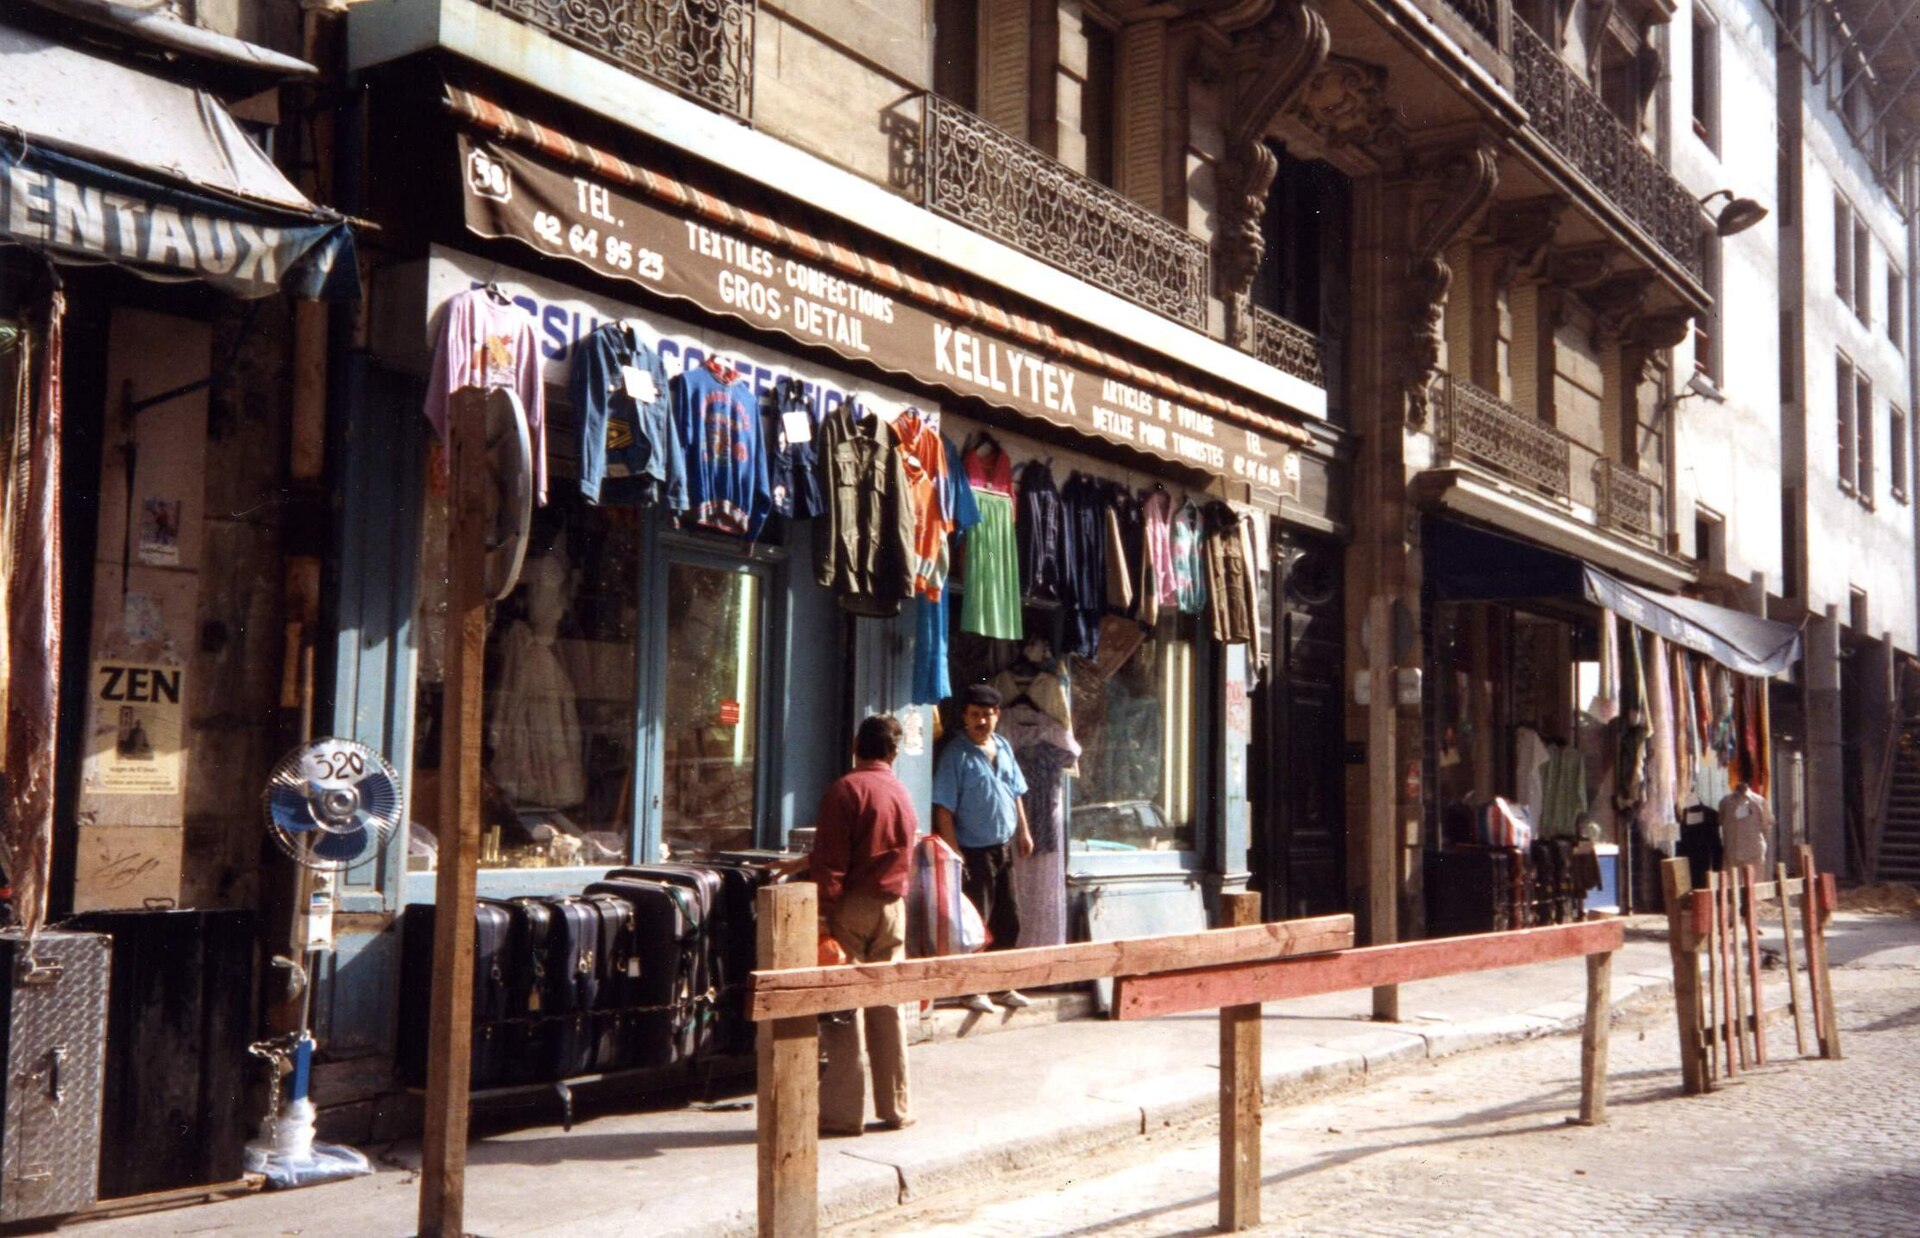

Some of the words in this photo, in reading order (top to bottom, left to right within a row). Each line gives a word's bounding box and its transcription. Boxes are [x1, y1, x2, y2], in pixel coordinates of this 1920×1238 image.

[573, 177, 625, 228] TEL.
[533, 210, 563, 246] 42
[568, 223, 598, 258] 64
[605, 236, 632, 270] 95
[685, 220, 774, 278] TEXTILES
[785, 260, 894, 325] CONFECTIONS
[718, 269, 782, 321] GROS
[794, 296, 871, 353] DETAIL
[933, 322, 1077, 416] KELLYTEX
[1102, 378, 1153, 416] ARTICLES
[1158, 397, 1172, 423] DE
[1091, 404, 1135, 441] DETAXE
[1139, 420, 1167, 451] POUR
[1171, 430, 1225, 469] TOURISTES
[99, 666, 182, 704] ZEN
